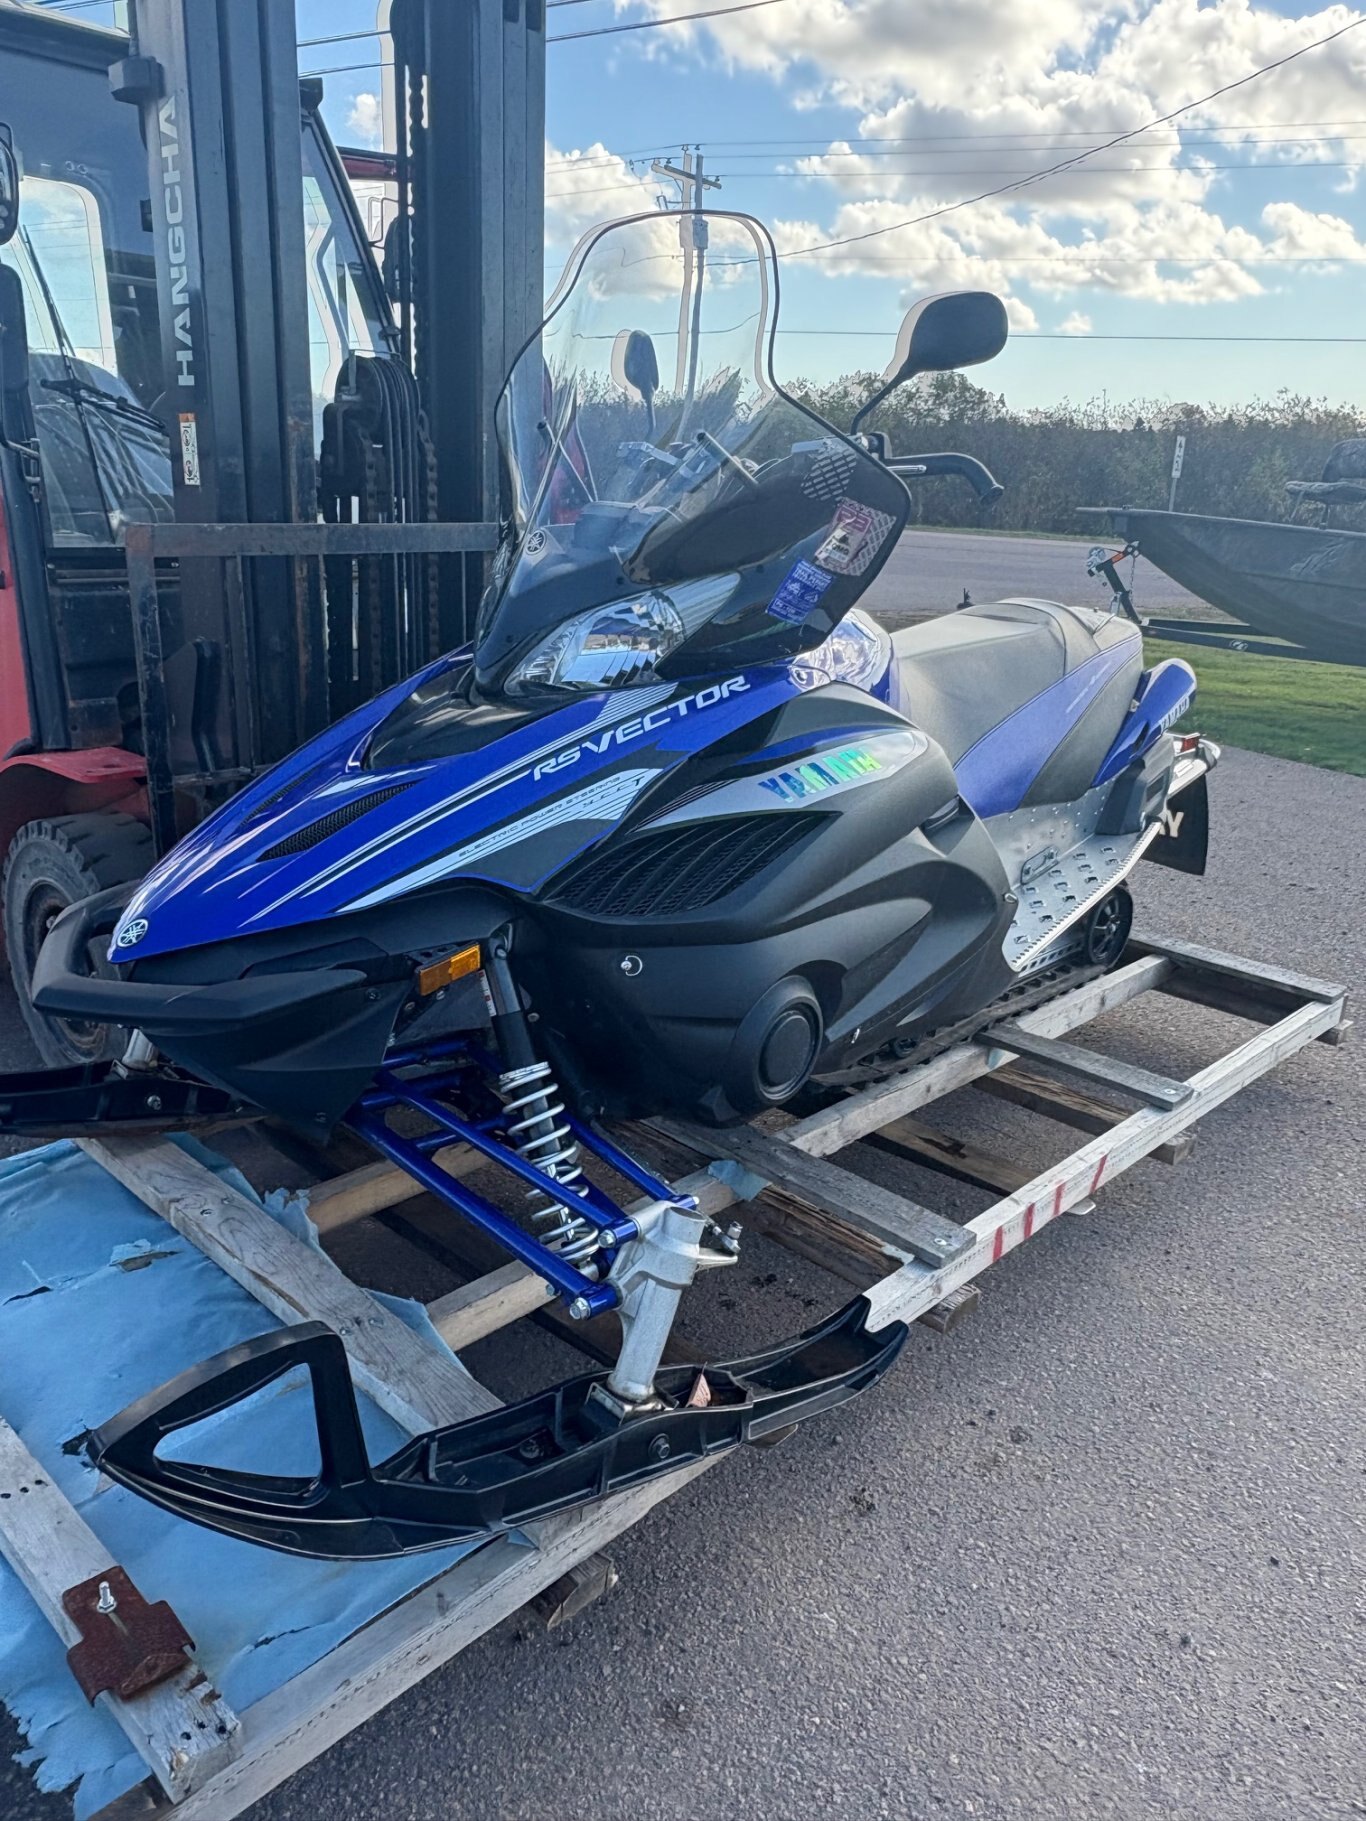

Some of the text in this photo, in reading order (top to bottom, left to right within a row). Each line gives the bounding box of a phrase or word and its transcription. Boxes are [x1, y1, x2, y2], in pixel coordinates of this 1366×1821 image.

[158, 95, 195, 386] HANGCHA
[533, 675, 751, 781] RS VECTOR
[458, 824, 519, 857] ELECTRIC
[520, 802, 564, 830] POWER
[565, 776, 622, 805] STEERING
